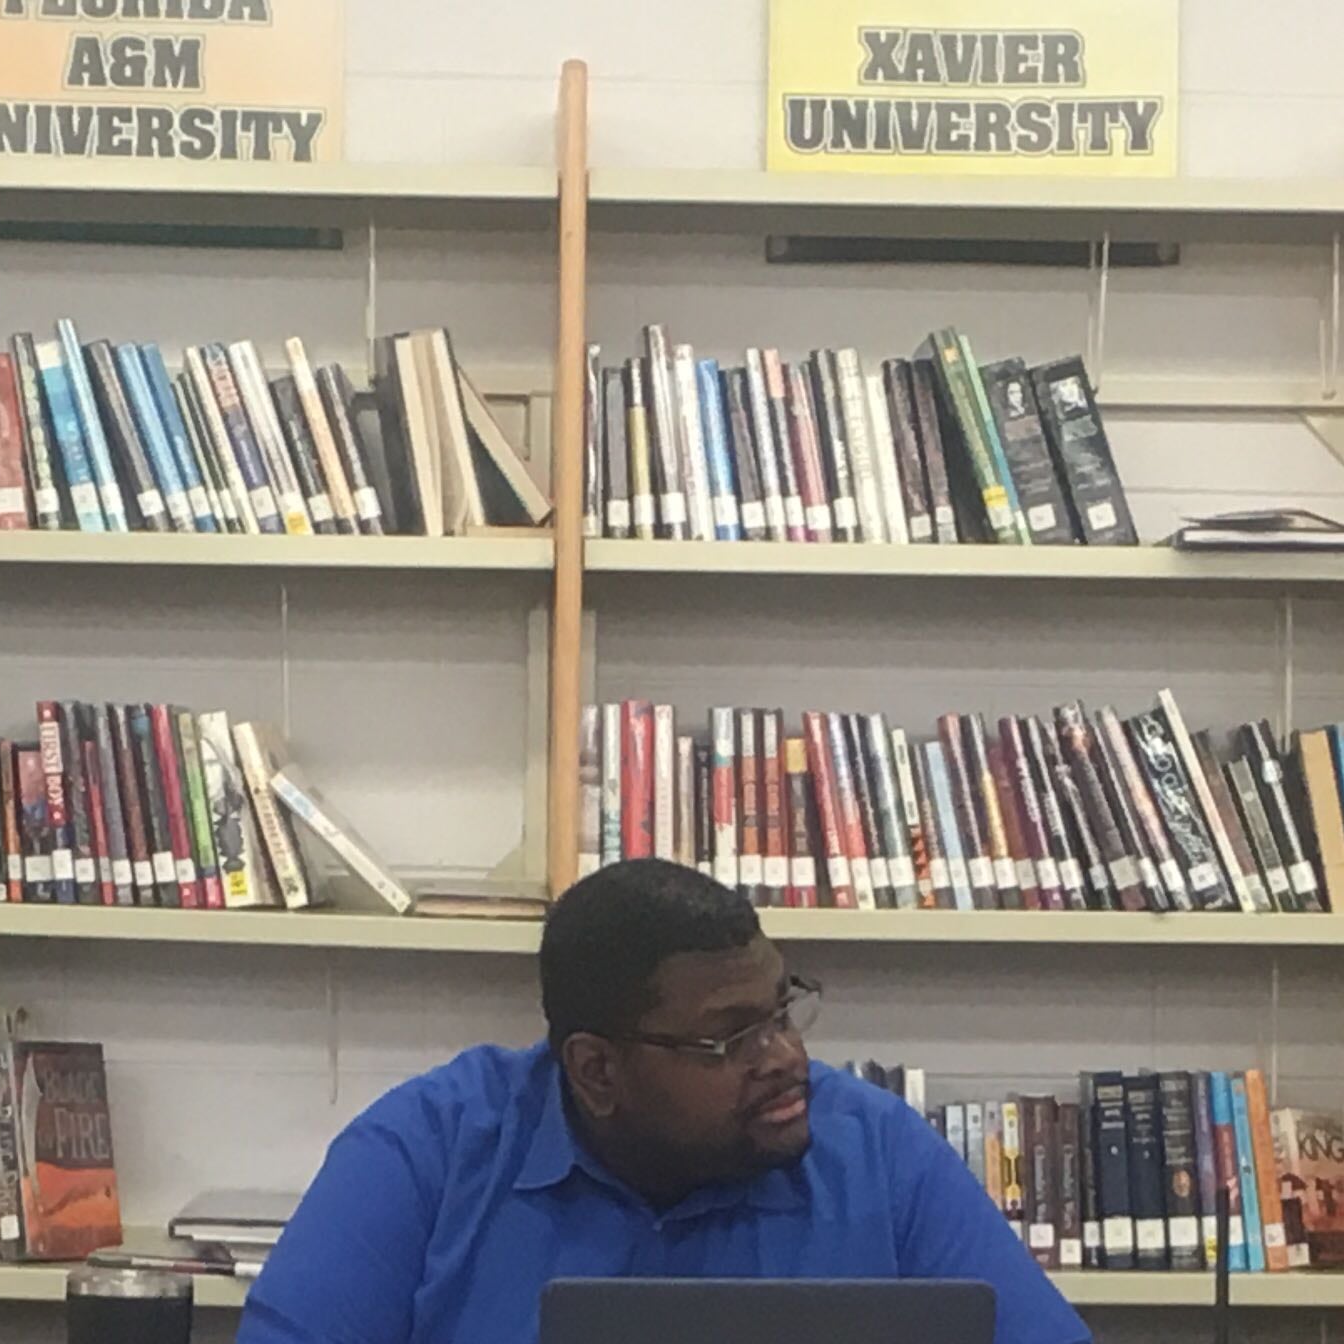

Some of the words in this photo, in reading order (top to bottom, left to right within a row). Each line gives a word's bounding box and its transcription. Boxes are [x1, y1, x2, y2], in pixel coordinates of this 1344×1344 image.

[65, 36, 202, 90] A&M
[862, 30, 1083, 86] XAVIER
[786, 98, 1160, 154] UNIVERSITY
[54, 1107, 110, 1160] FIRE
